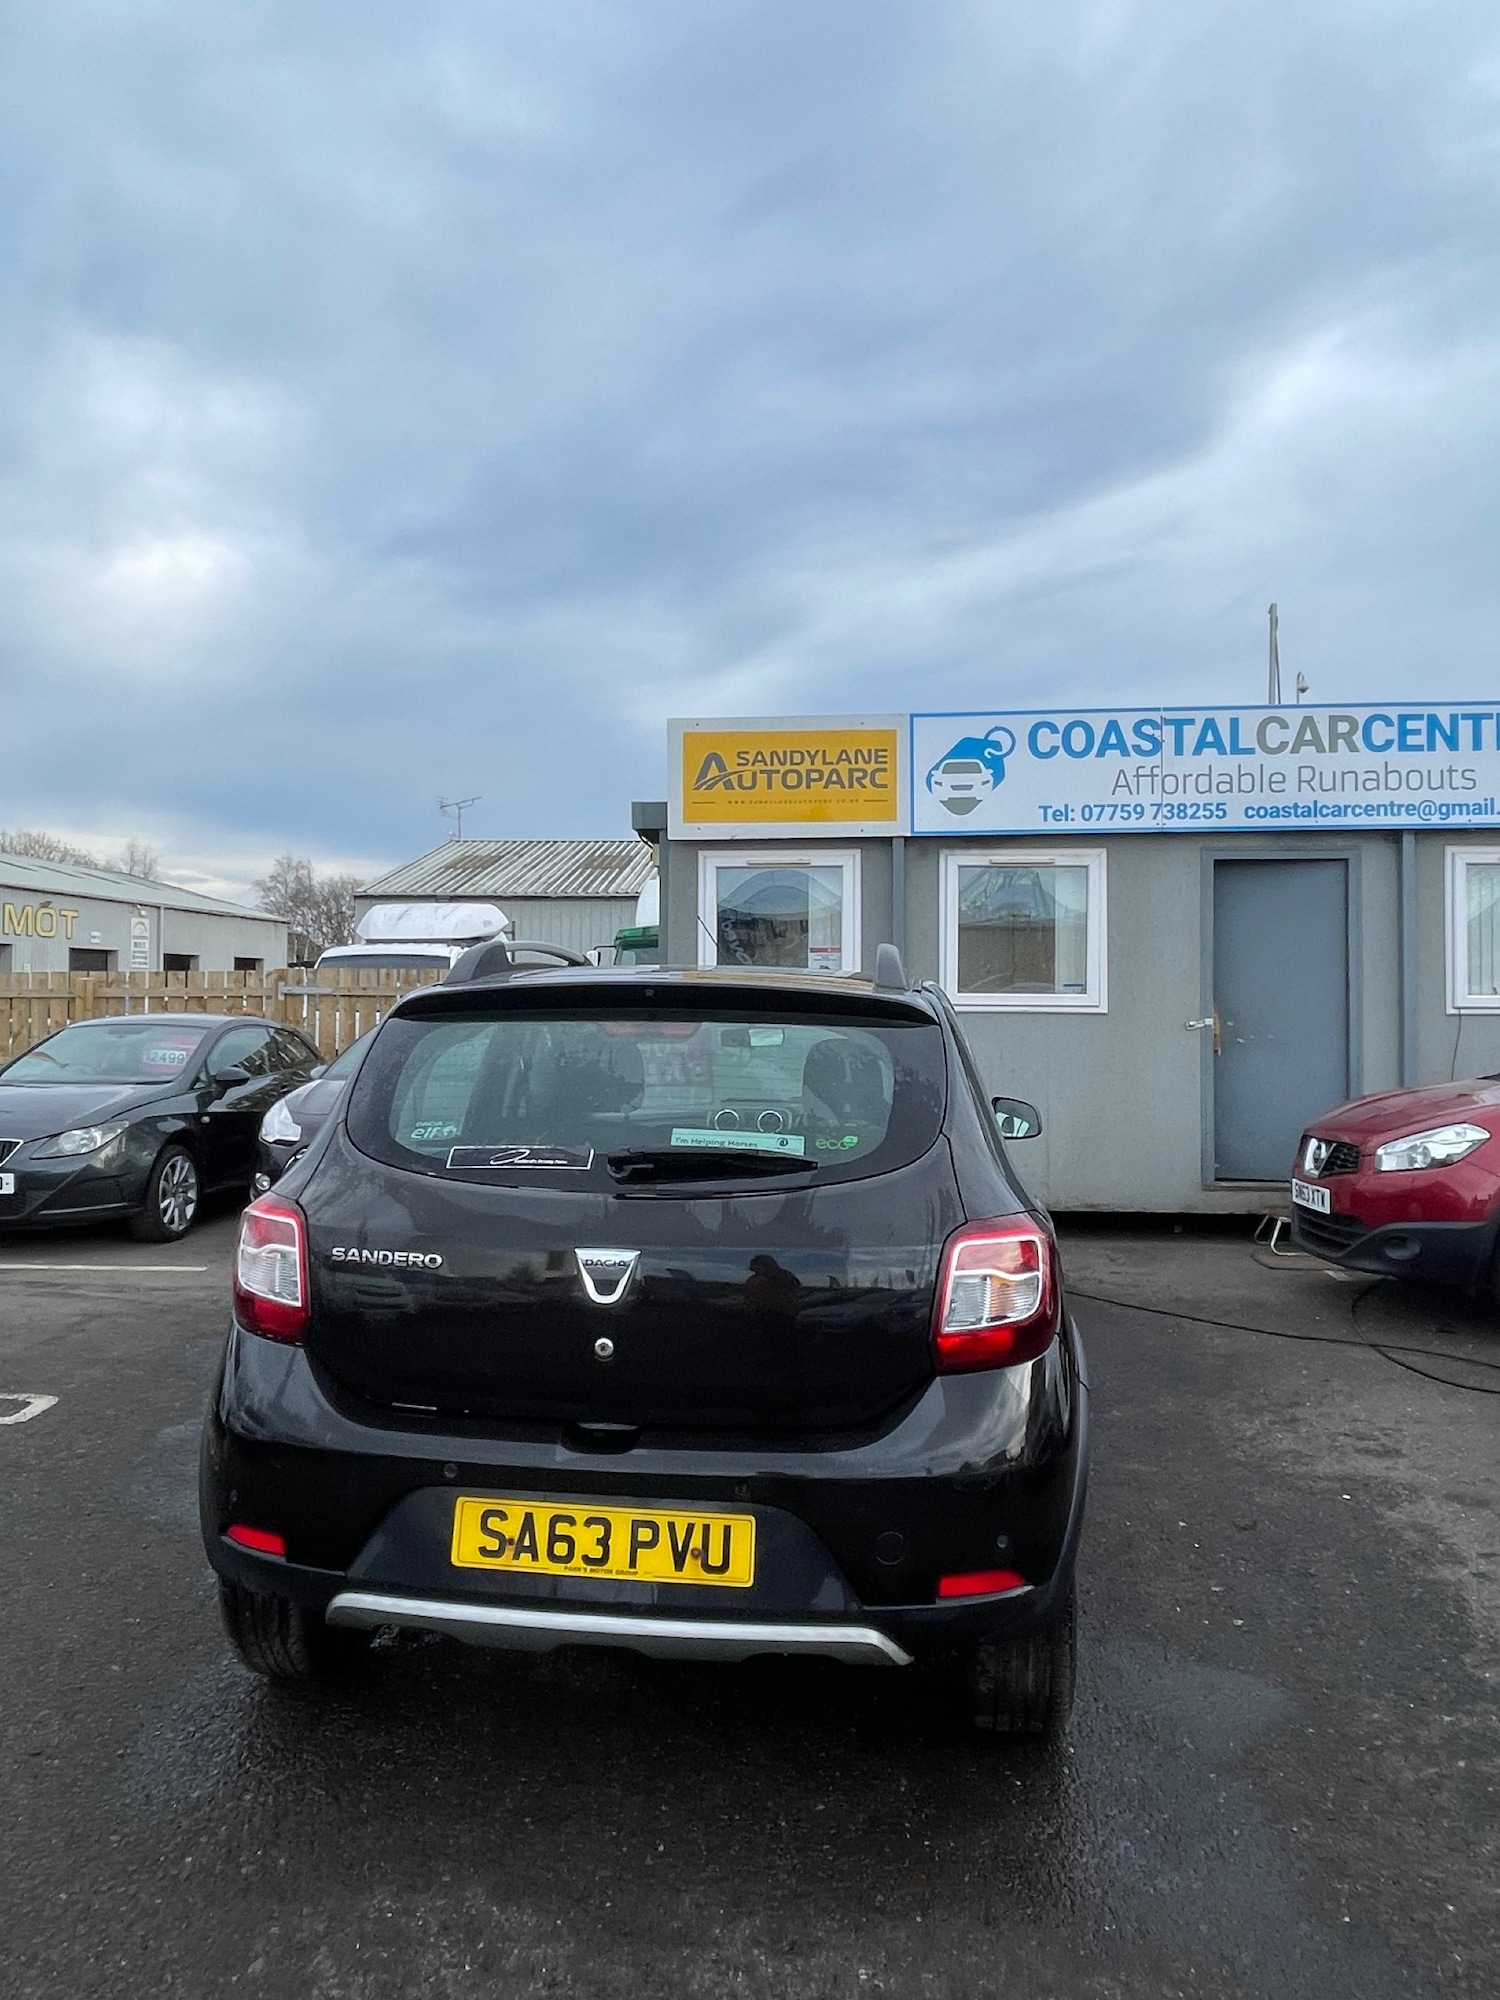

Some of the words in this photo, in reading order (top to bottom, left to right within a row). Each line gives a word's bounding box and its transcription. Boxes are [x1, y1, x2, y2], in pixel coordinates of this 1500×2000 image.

[736, 748, 888, 767] SANDYLANE
[693, 752, 888, 791] AUTOPARC
[1111, 763, 1287, 796] Affordable
[1297, 761, 1477, 793] Runabouts
[1038, 803, 1075, 823] Tel:
[1080, 803, 1145, 821] 07759
[1150, 802, 1227, 820] 738255
[3, 902, 79, 940] MOT
[691, 1138, 726, 1147] Helping
[727, 1140, 758, 1148] Horses
[331, 1247, 444, 1269] SANDERO
[585, 1258, 627, 1267] DACIA
[478, 1508, 612, 1567] SA63
[628, 1518, 733, 1576] PVU
